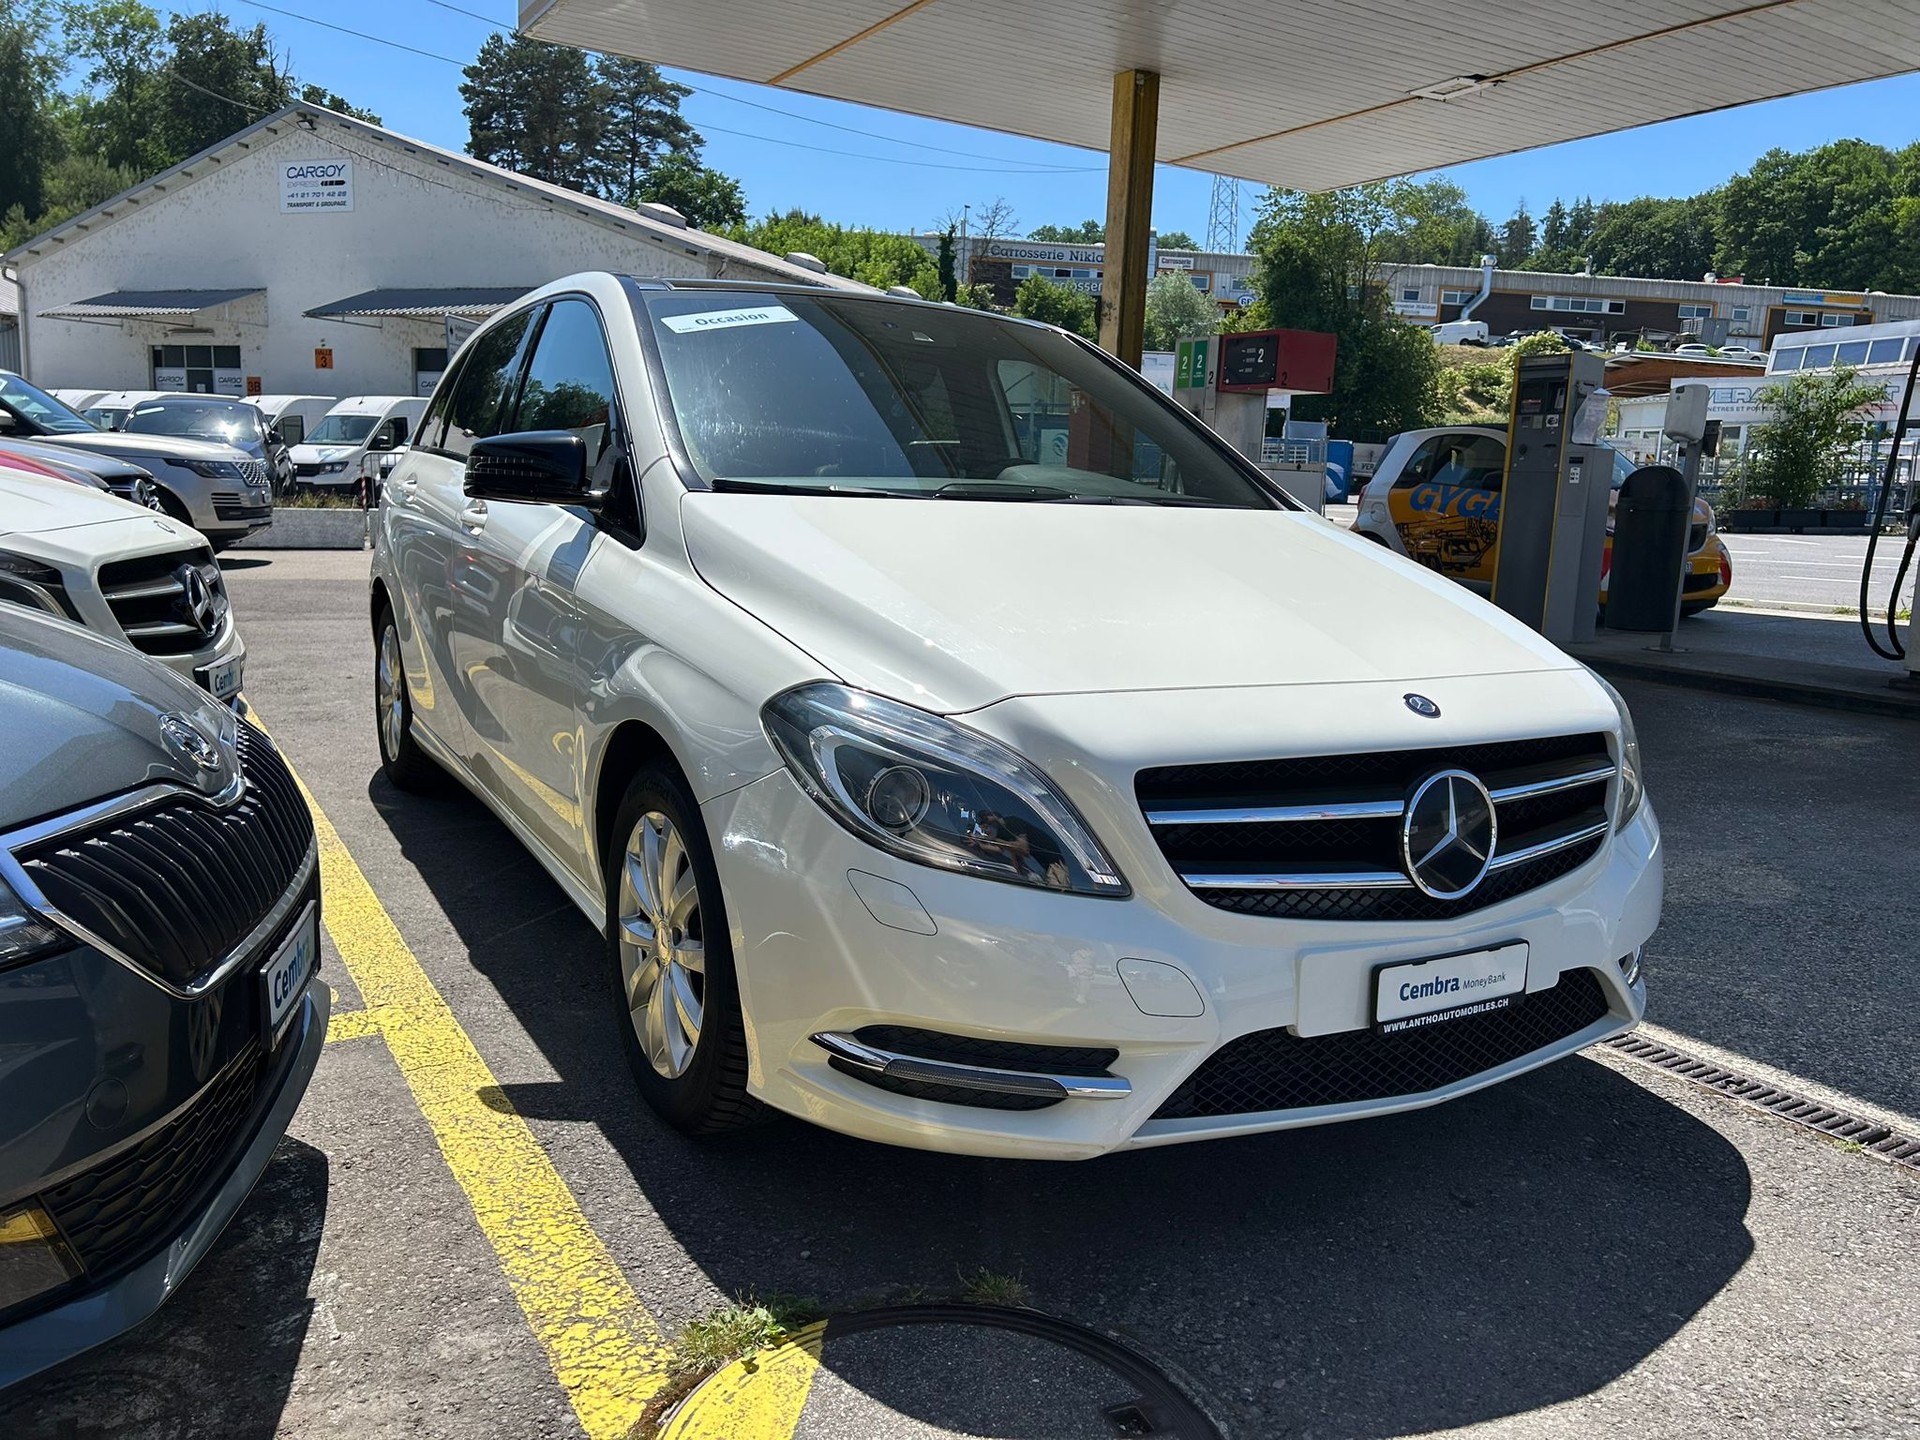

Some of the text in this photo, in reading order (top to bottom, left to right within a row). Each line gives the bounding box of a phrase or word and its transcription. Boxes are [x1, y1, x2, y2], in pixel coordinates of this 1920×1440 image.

[286, 164, 346, 179] CARGOY
[990, 245, 1065, 260] Carrosserie
[695, 312, 769, 326] Occasion
[320, 356, 327, 368] 3
[1181, 355, 1188, 370] 2
[1196, 354, 1203, 369] 2
[1257, 348, 1265, 363] 2
[1208, 371, 1214, 384] 2
[1281, 371, 1288, 386] 2
[248, 381, 260, 392] 3B
[274, 935, 311, 1008] Cembra
[1399, 972, 1507, 1001] Cembra MoneyBank
[1383, 998, 1509, 1033] WWW.ANTHOAUTOMOBILES.CH
